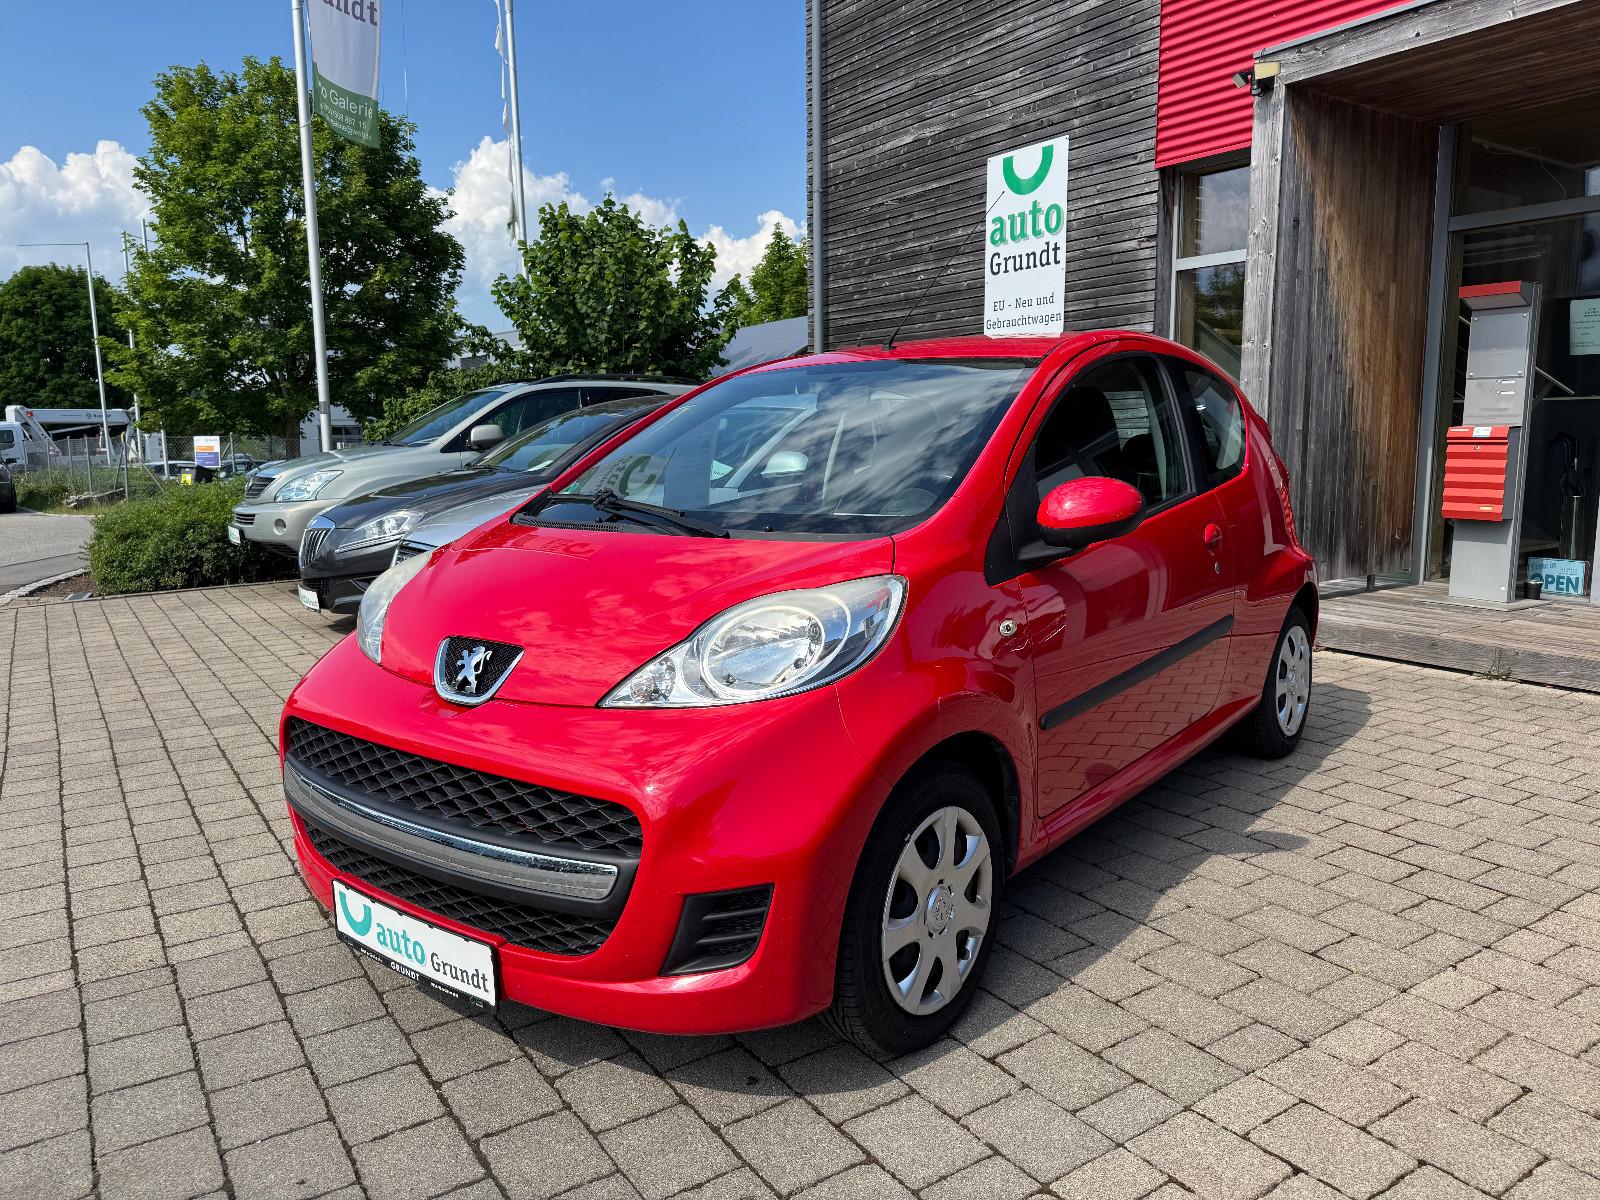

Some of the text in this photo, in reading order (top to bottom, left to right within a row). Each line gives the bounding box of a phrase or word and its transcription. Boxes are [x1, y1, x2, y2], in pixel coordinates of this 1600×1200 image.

[989, 200, 1063, 246] auto
[990, 242, 1061, 276] Grundt
[993, 300, 1005, 312] EU
[1015, 297, 1033, 309] Neu
[1036, 293, 1054, 306] und
[986, 311, 1062, 330] Gebrauchtwagen
[376, 922, 489, 994] auto Grundt
[390, 961, 420, 981] GRUNDT
